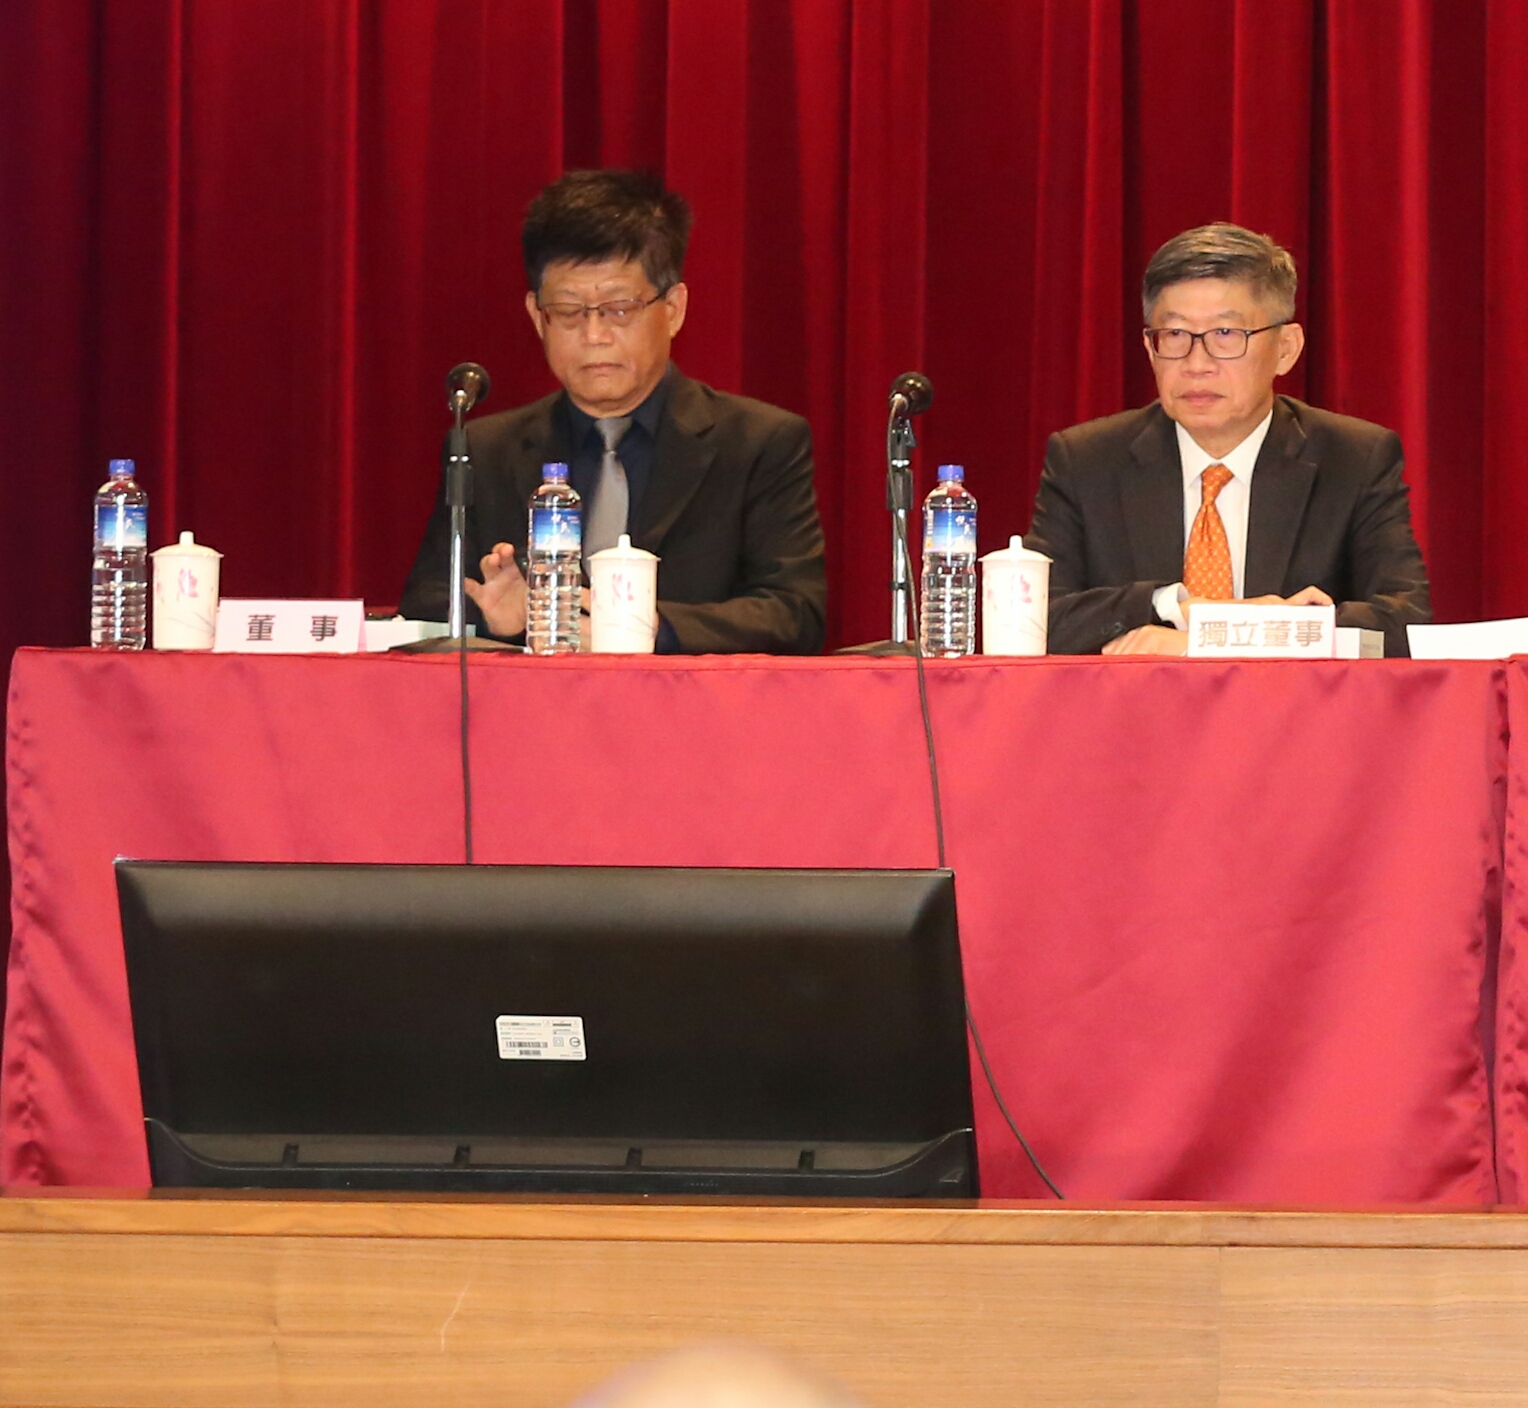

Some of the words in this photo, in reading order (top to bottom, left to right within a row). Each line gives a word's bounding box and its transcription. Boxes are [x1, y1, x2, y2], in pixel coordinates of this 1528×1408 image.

[246, 614, 338, 642] 董事
[1198, 619, 1323, 648] 獨立董事
